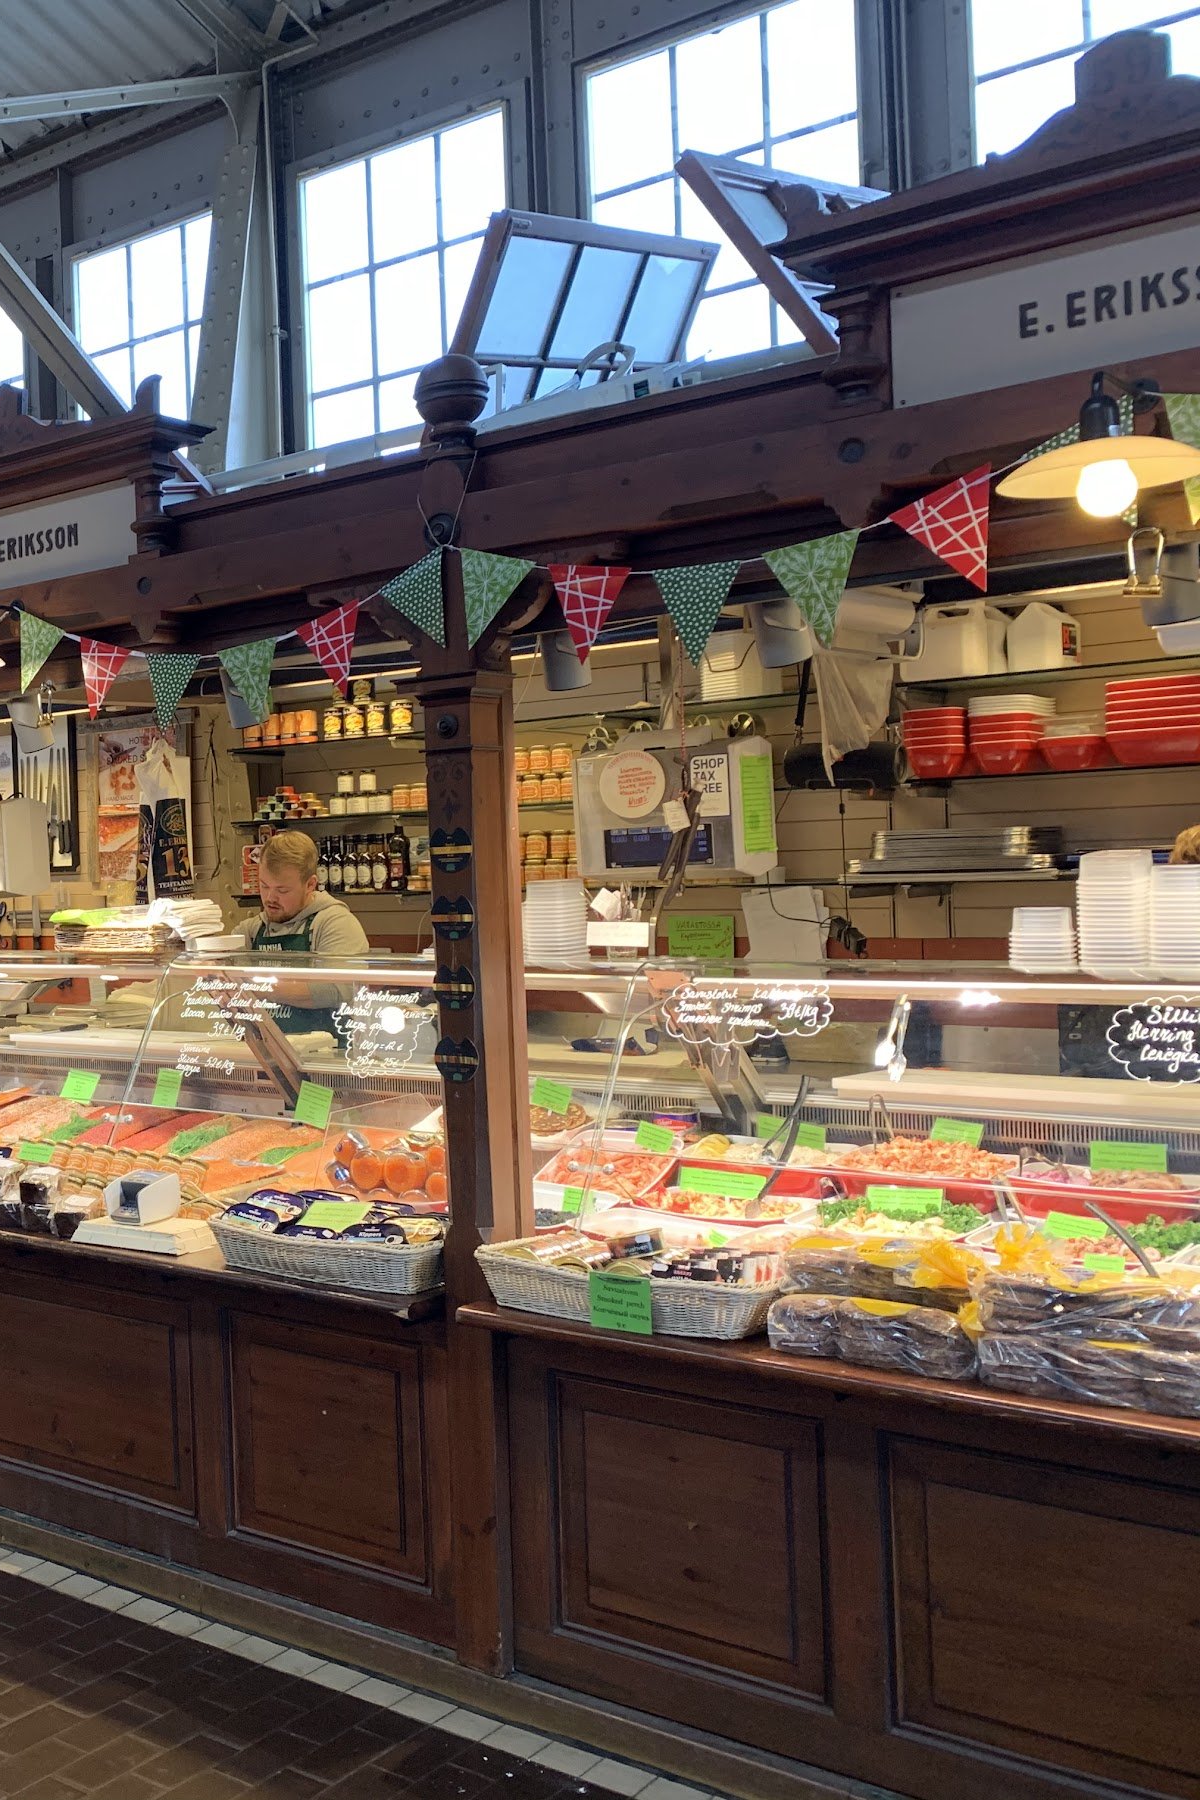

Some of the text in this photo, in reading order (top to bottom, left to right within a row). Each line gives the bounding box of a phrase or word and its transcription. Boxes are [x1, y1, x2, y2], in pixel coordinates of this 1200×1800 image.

[129, 736, 145, 745] HOT
[693, 758, 724, 770] SHOP
[693, 771, 715, 781] TAX
[702, 783, 723, 793] REE
[1127, 1020, 1196, 1052] Herring
[597, 1294, 623, 1305] Smoked
